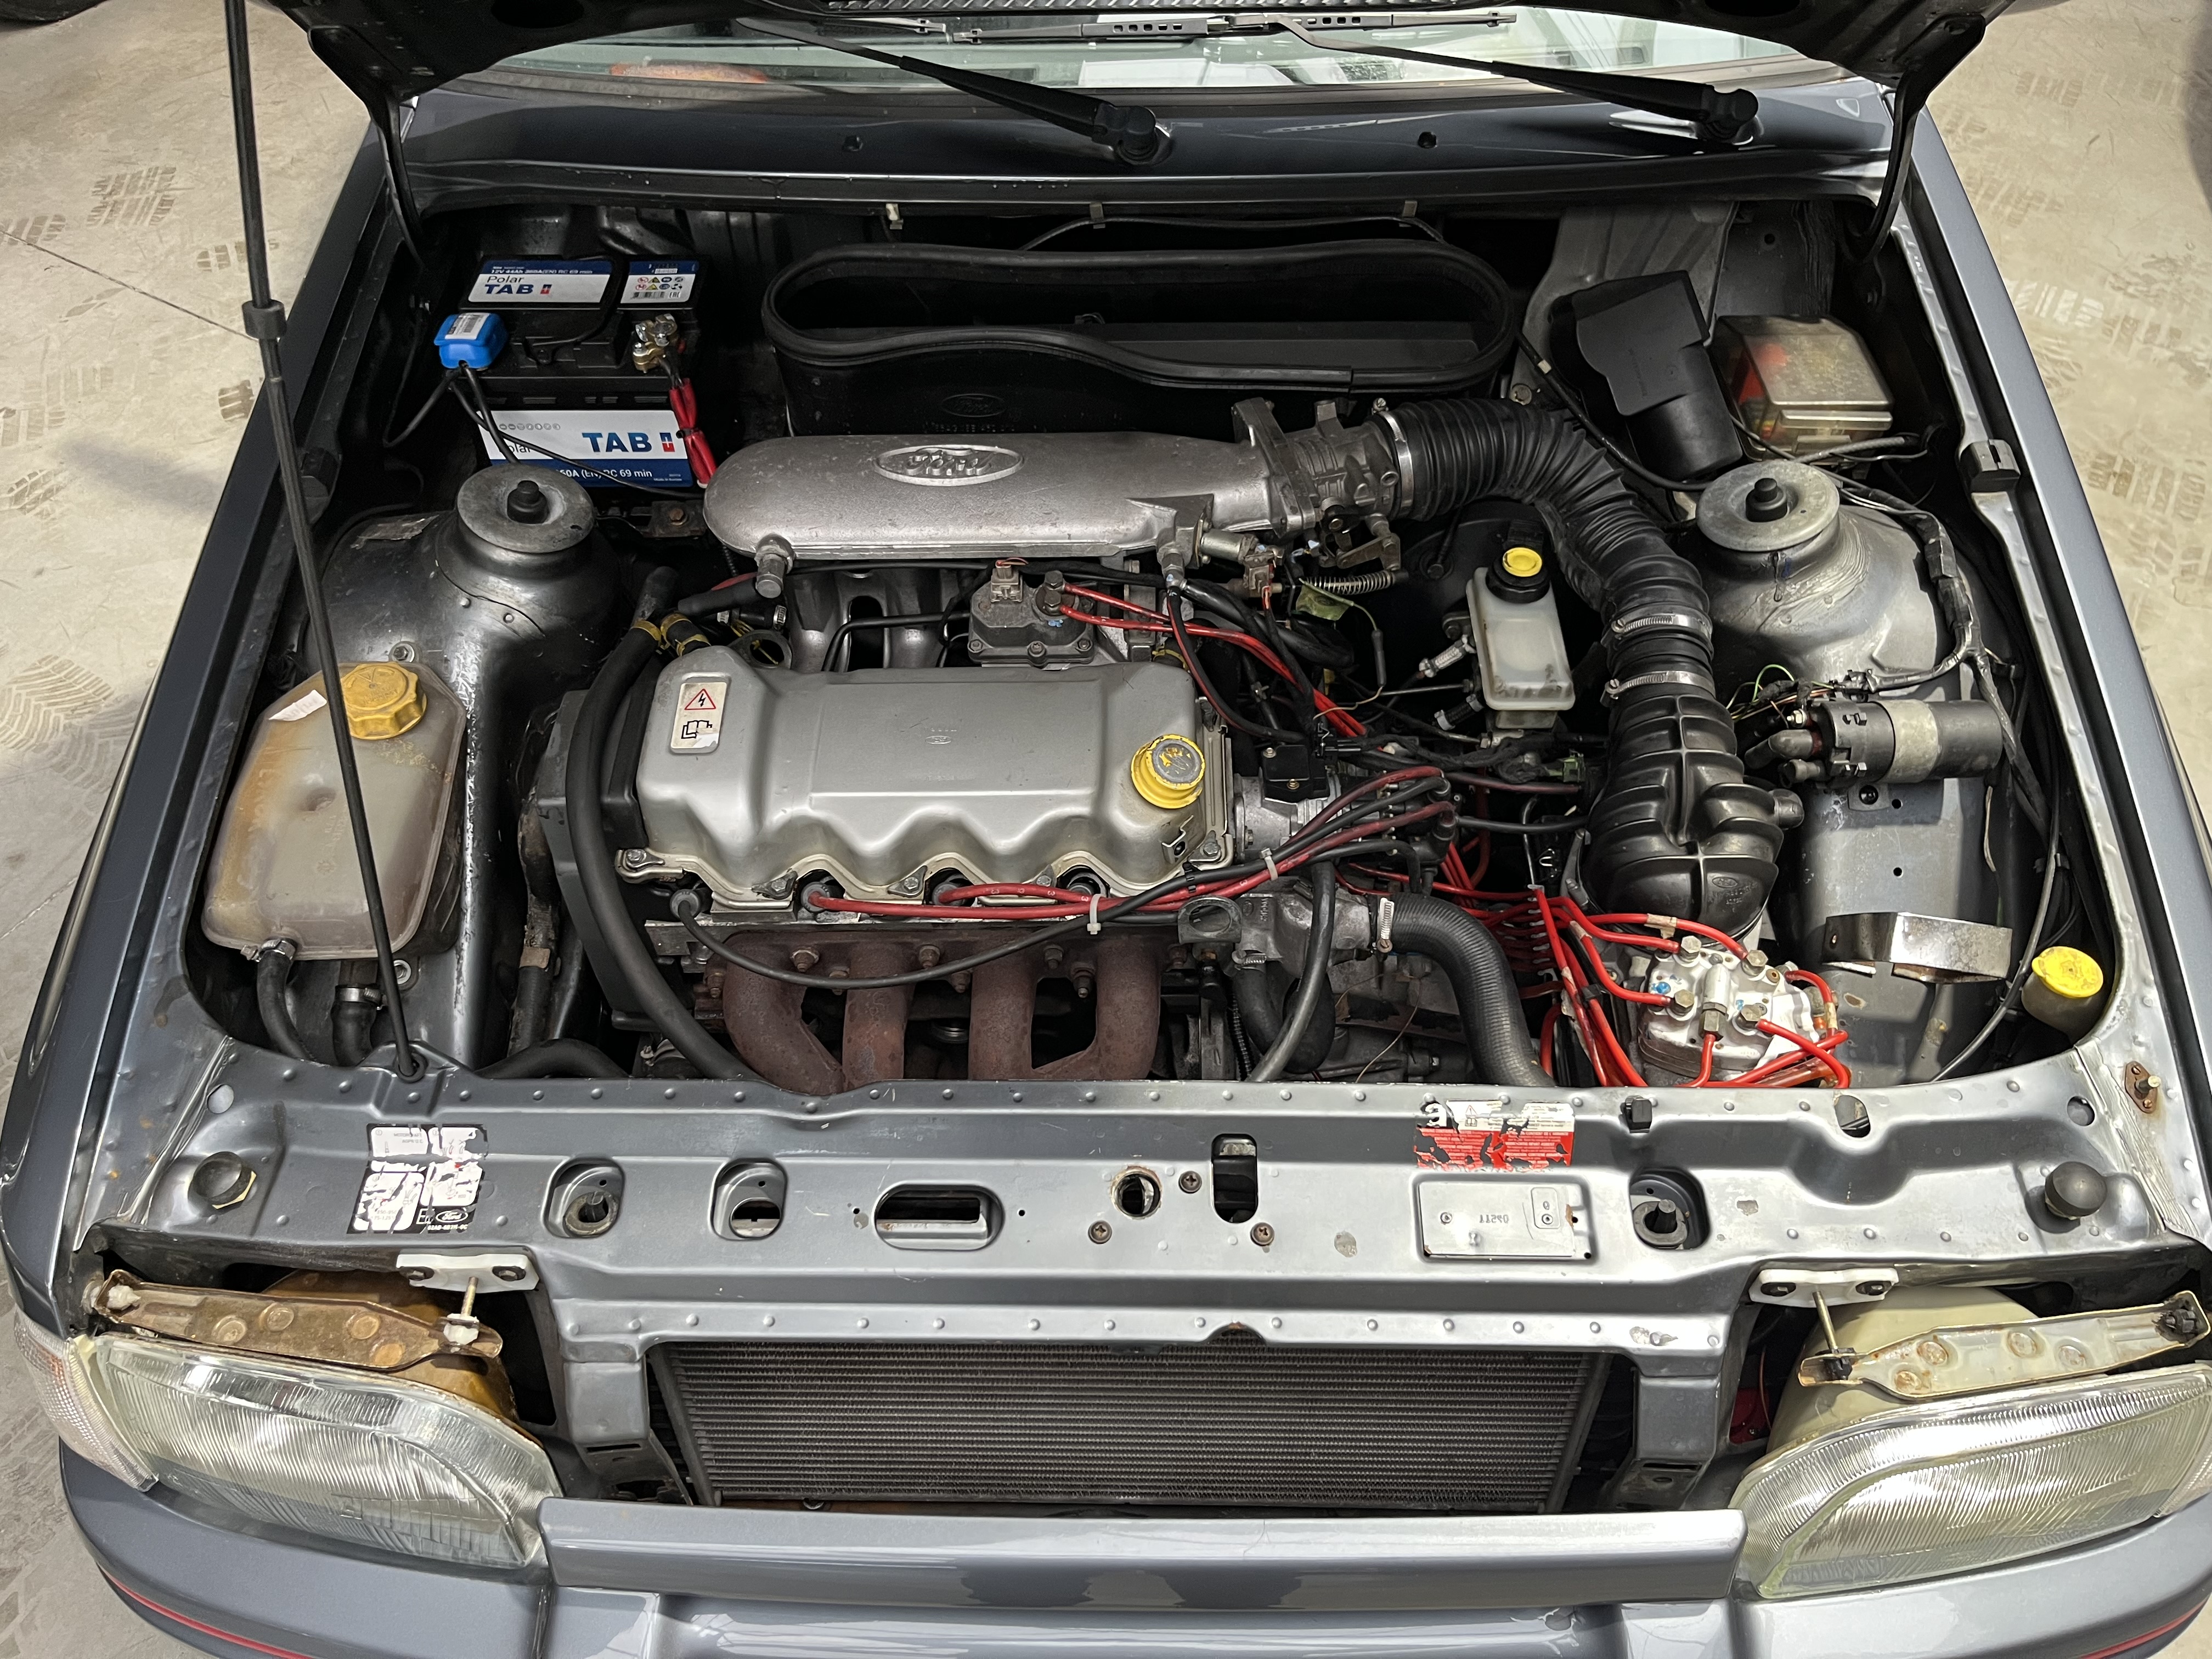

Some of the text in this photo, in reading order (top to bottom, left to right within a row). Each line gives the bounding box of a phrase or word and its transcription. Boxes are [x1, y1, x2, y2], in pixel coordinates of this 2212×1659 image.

[484, 284, 534, 294] TAB
[582, 432, 652, 453] TAB
[557, 469, 580, 477] 60A
[619, 469, 631, 477] 69
[634, 469, 652, 477] min
